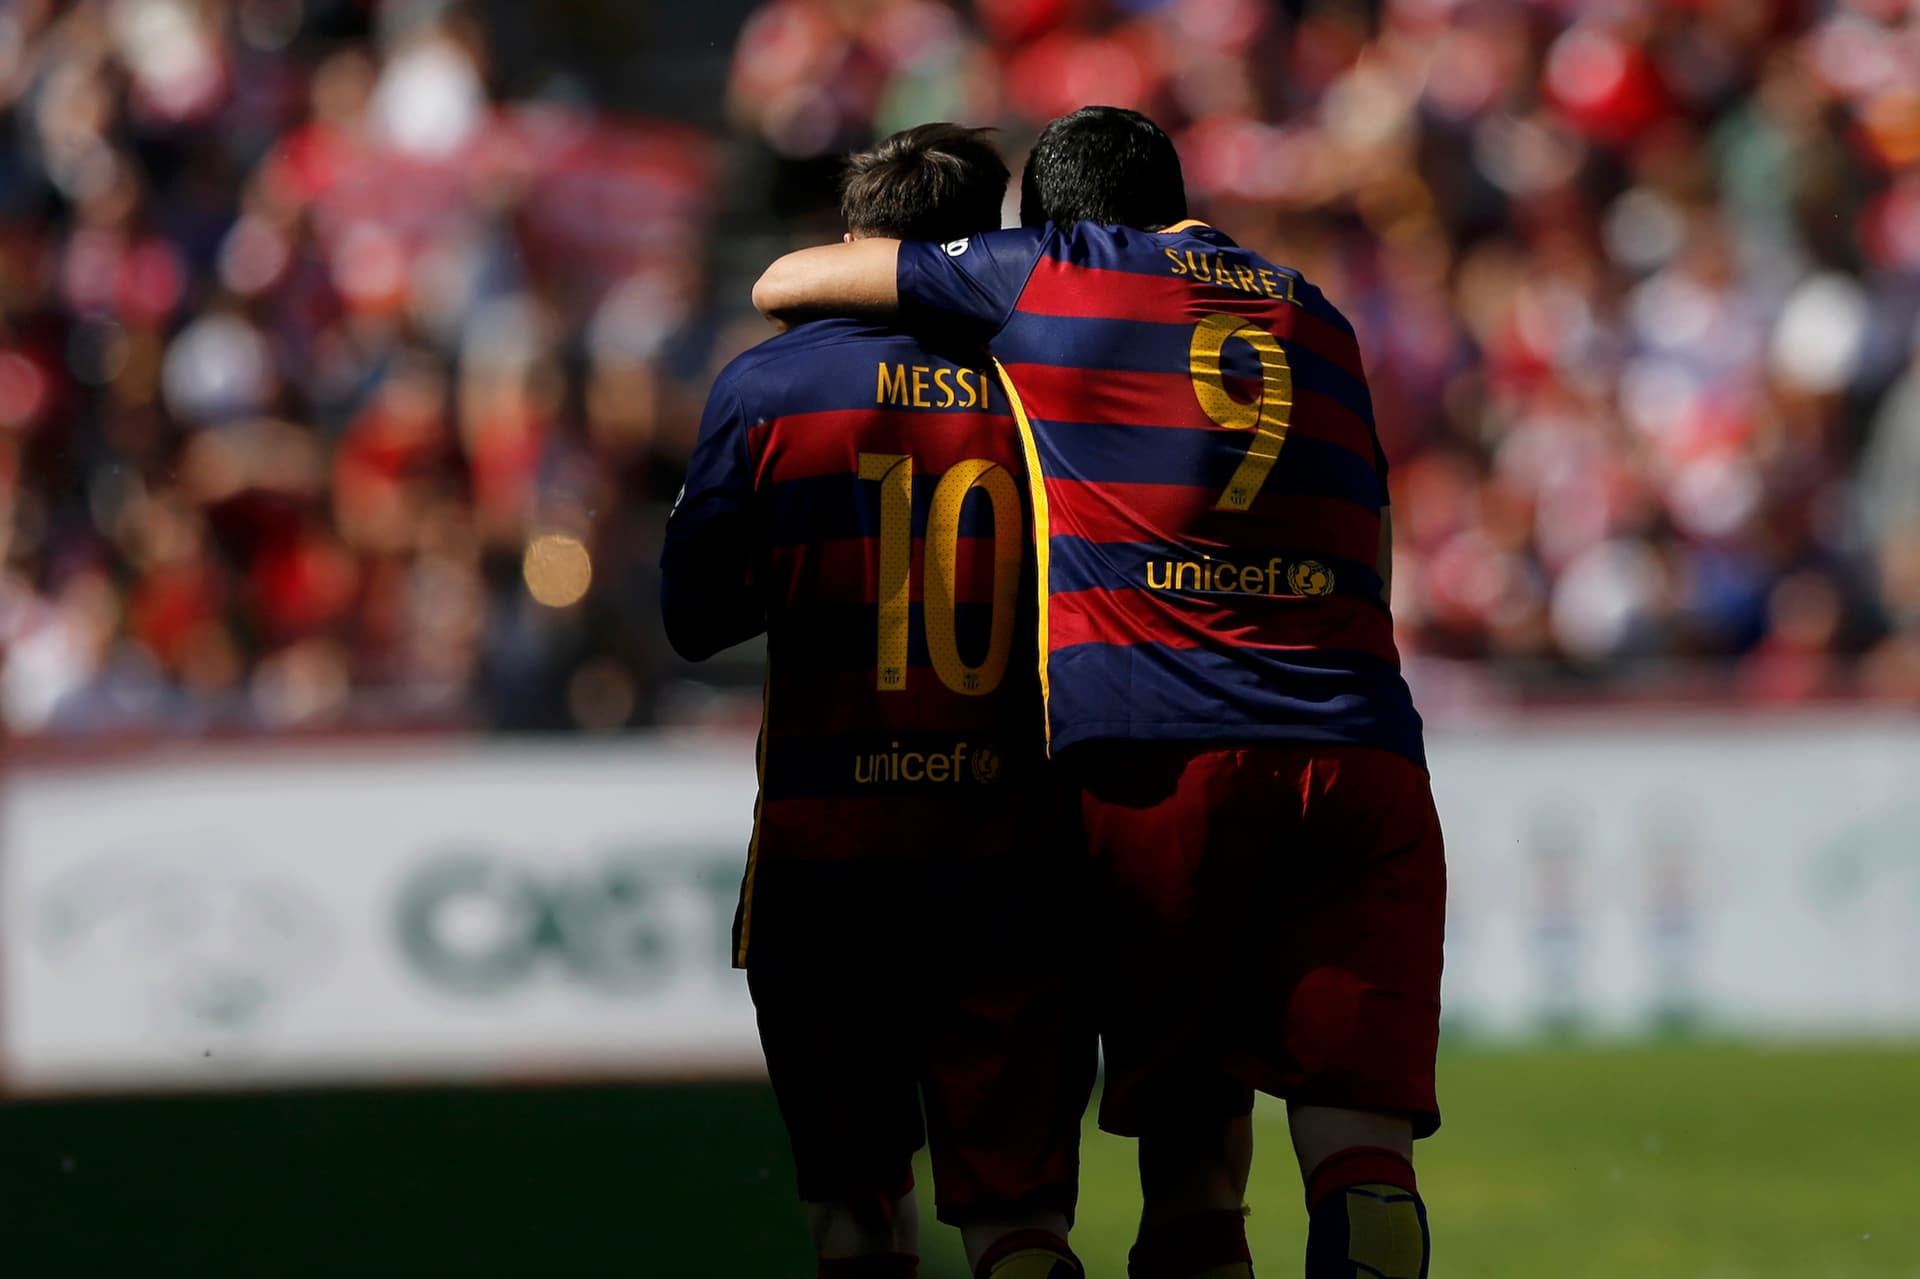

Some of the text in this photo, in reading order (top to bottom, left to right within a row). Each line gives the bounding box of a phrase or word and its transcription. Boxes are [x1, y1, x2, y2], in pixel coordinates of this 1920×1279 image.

[1164, 247, 1304, 308] SUÁREZ
[876, 361, 990, 409] MESSI
[1189, 313, 1293, 511] 9
[857, 452, 1022, 696] 10
[1145, 554, 1283, 595] unicef
[854, 740, 968, 784] unicef
